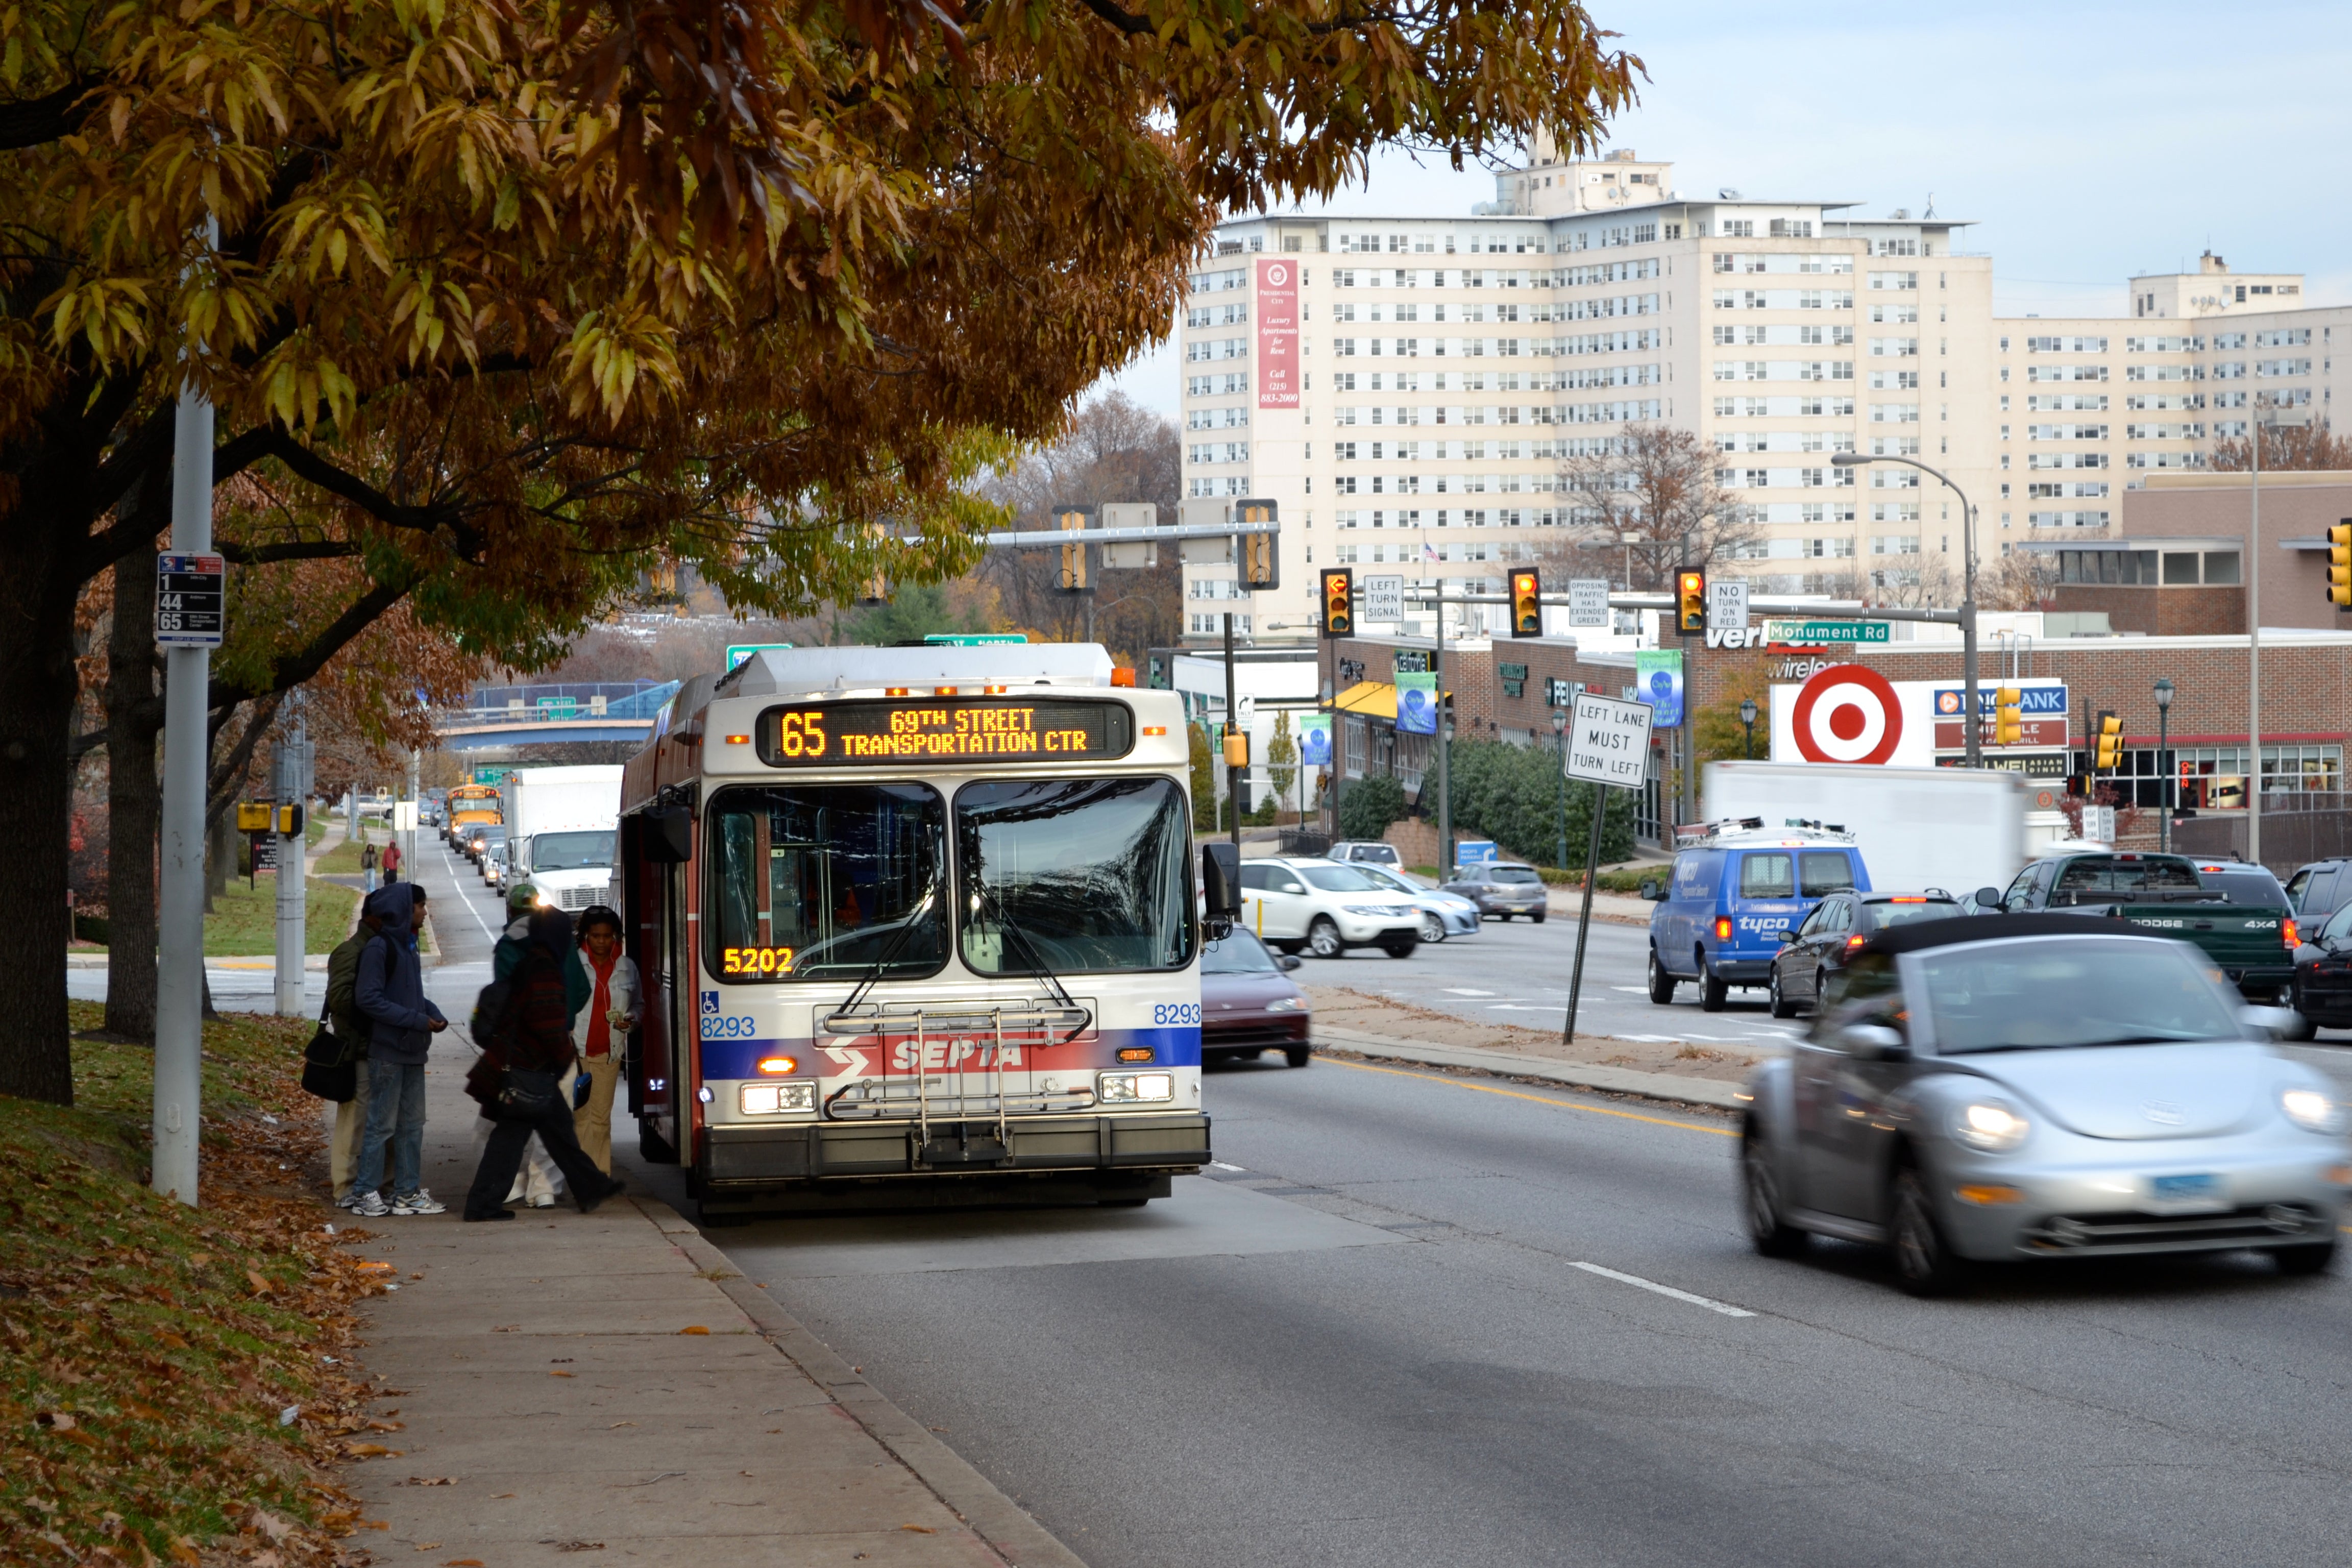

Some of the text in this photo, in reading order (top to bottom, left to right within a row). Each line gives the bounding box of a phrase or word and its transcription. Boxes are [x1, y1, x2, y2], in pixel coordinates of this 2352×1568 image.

[1267, 316, 1290, 325] Luxury
[1261, 327, 1298, 336] Apartments
[1270, 370, 1285, 378] Call
[1269, 382, 1287, 391] (215)
[1261, 394, 1298, 403] 883-2000
[162, 574, 169, 590] 1
[1371, 581, 1396, 590] LEFT
[1370, 594, 1398, 603] TURN
[1720, 586, 1738, 596] NO
[160, 594, 182, 610] 44
[1368, 607, 1401, 617] SIGNAL
[160, 613, 181, 630] 65
[1771, 625, 1885, 639] Monument Rd
[1655, 699, 1672, 708] The
[2008, 692, 2061, 709] ANK
[1581, 705, 1645, 727] LEFT LANE
[1655, 707, 1679, 716] mart
[891, 708, 1034, 733] 69TH STREET
[781, 713, 826, 756] 65
[841, 730, 1087, 755] TRANSPORTATION CTR
[1589, 730, 1630, 750] MUST
[1575, 753, 1640, 776] TURN LEFT
[1739, 916, 1790, 933] tyco
[725, 948, 792, 972] 5202
[1155, 1003, 1201, 1025] 8293
[701, 1016, 755, 1038] 8293
[892, 1038, 1022, 1070] SEPTA
